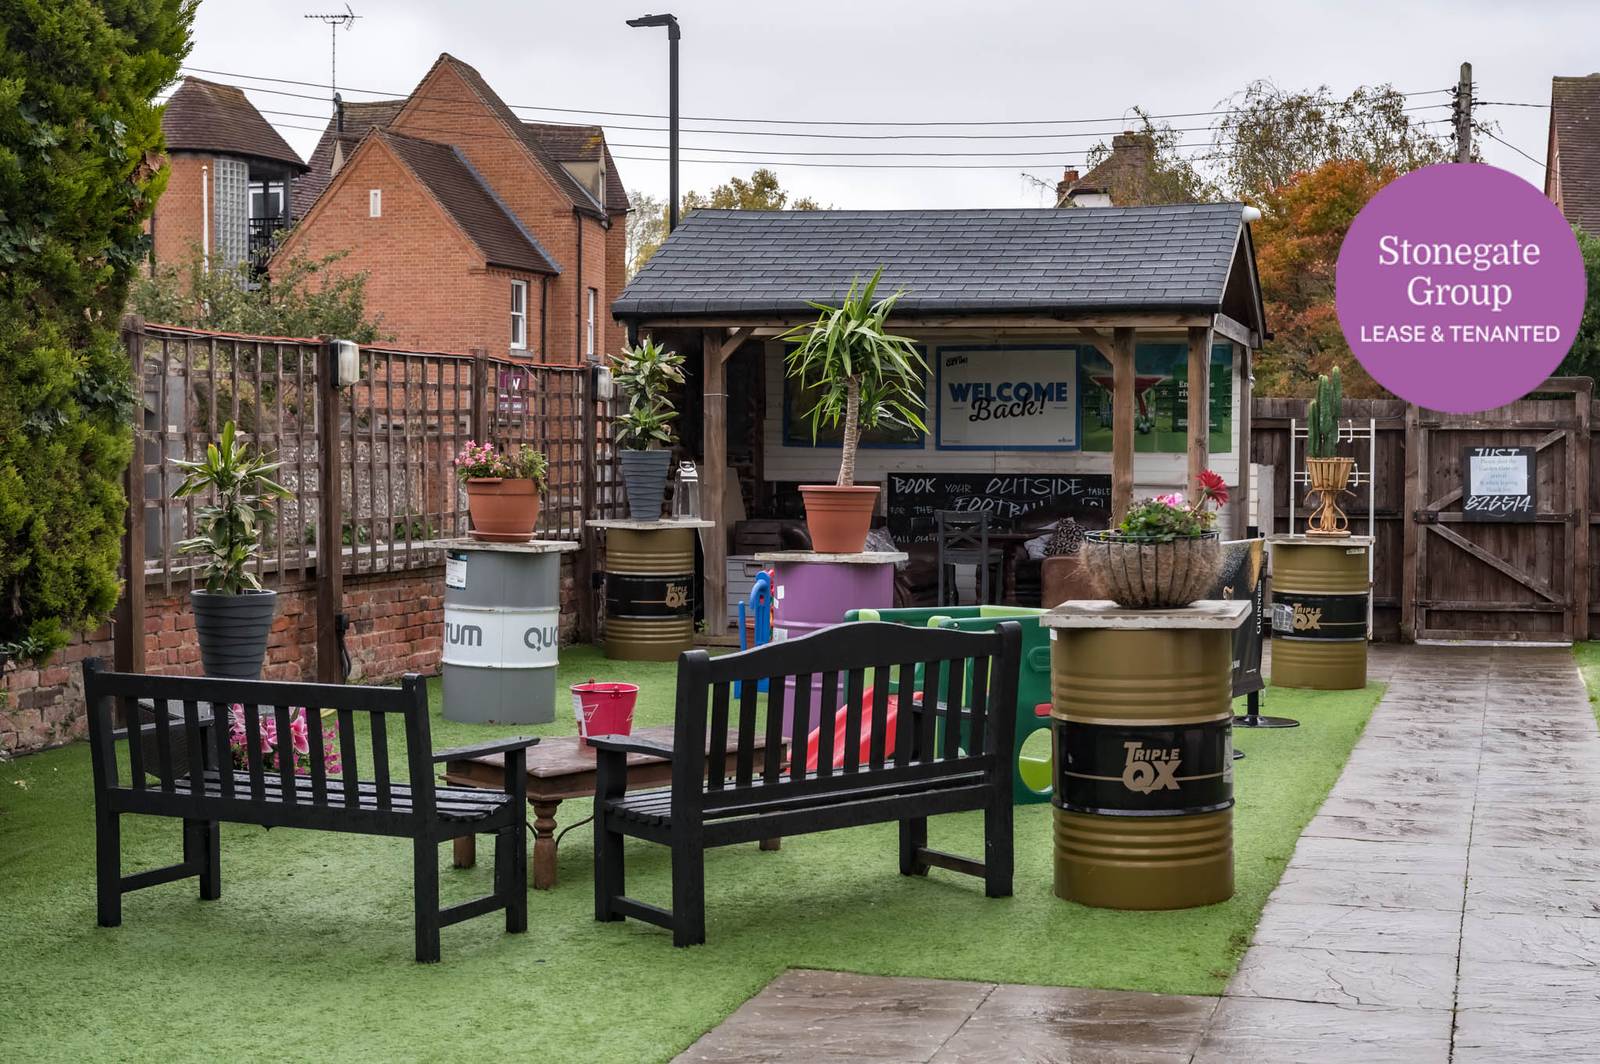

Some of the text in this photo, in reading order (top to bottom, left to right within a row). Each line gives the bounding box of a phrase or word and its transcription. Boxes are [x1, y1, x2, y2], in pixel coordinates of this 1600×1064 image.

[948, 382, 1068, 402] WELCOME
[968, 388, 1047, 422] Back!
[891, 476, 937, 493] BOOK
[985, 477, 1083, 496] OUTSIDE
[913, 505, 934, 514] THE
[954, 496, 1044, 518] FOOTBA
[1464, 495, 1534, 512] 826514
[1292, 603, 1321, 615] TRIPLE
[523, 626, 559, 652] QU
[1124, 741, 1180, 766] TRIPLE
